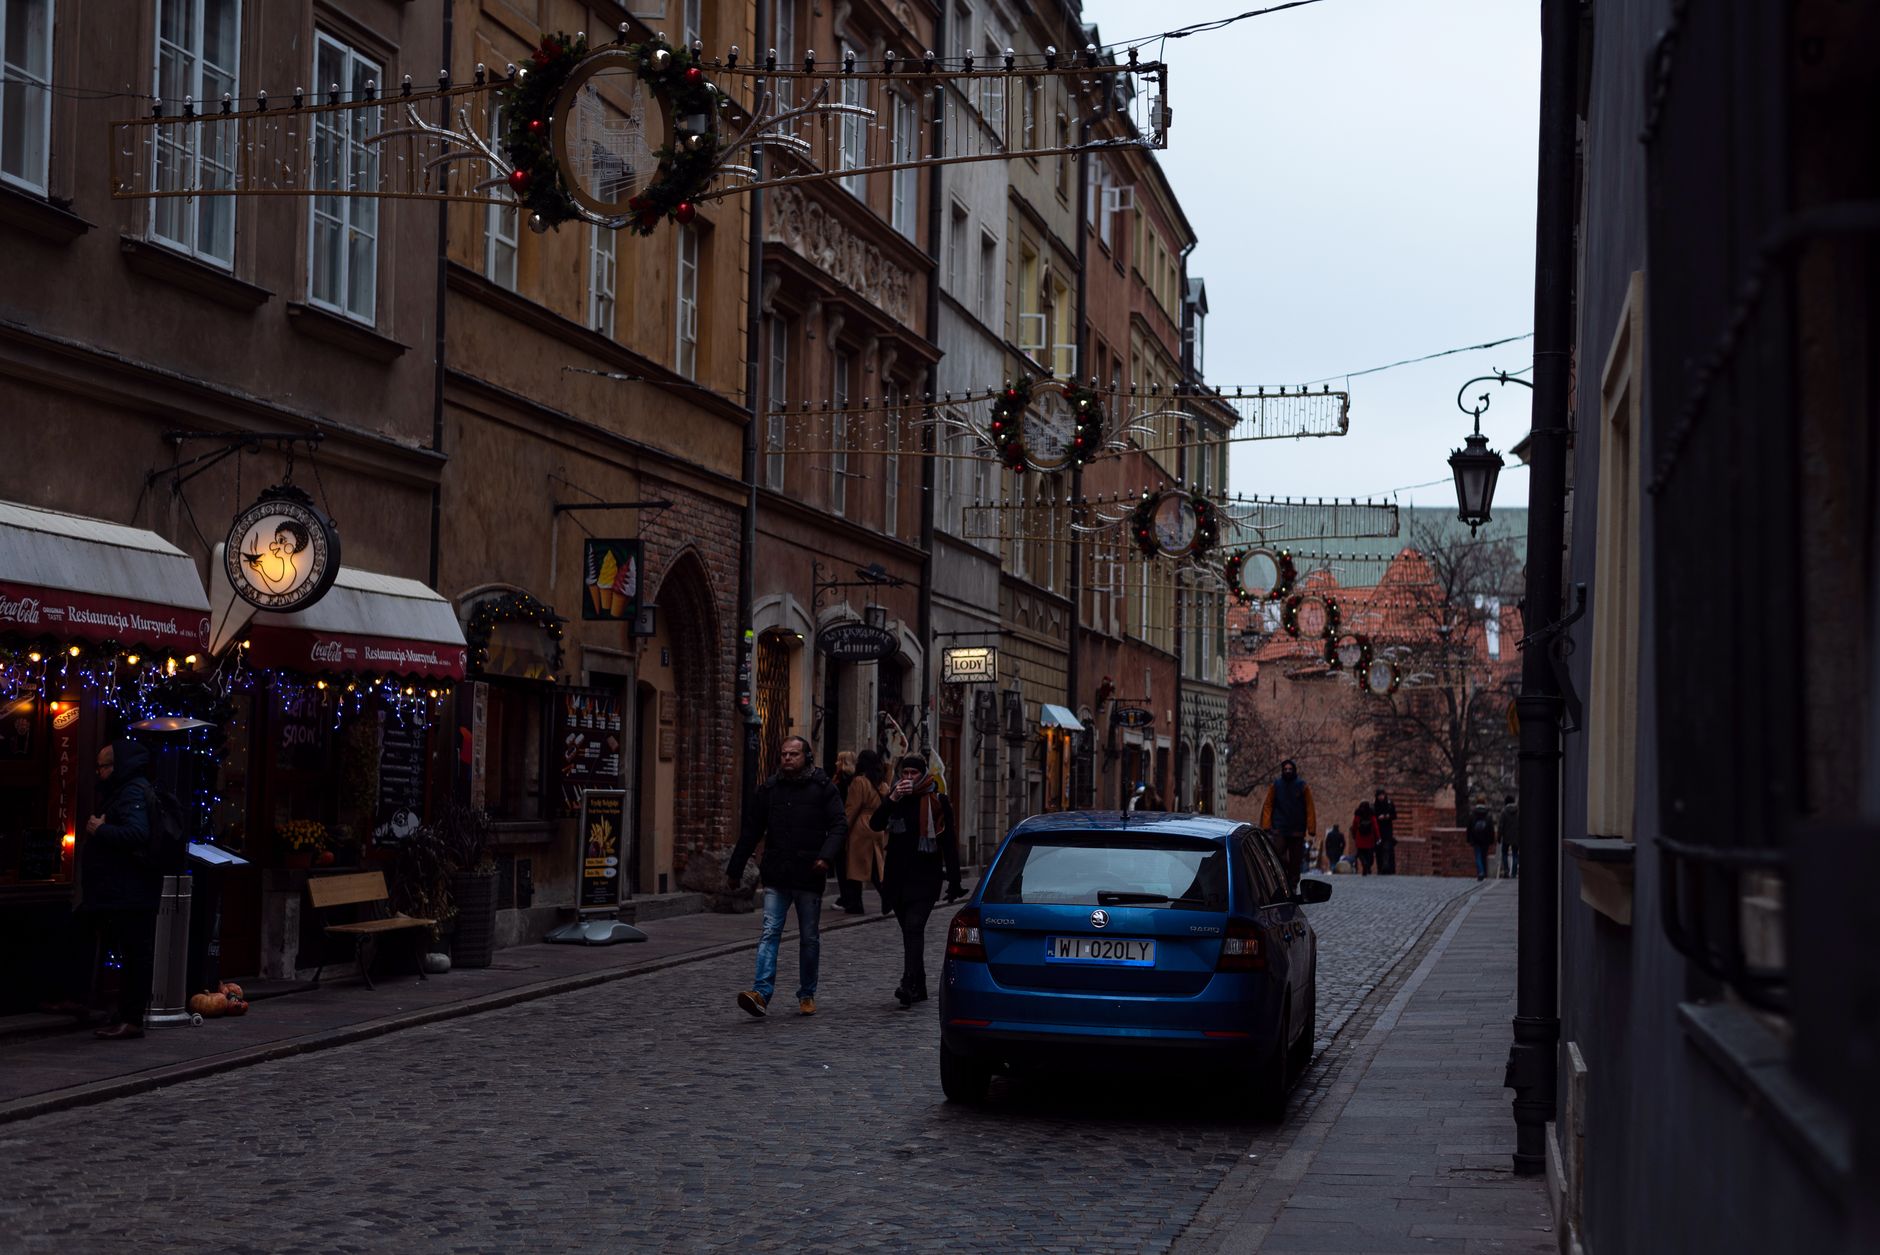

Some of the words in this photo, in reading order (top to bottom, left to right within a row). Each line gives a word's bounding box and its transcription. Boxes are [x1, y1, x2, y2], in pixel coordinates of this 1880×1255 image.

[68, 605, 129, 633] Restauracja
[130, 613, 177, 638] Murzynek
[954, 660, 982, 670] LODY
[1060, 939, 1080, 958] WI
[1090, 940, 1149, 961] 020LY
